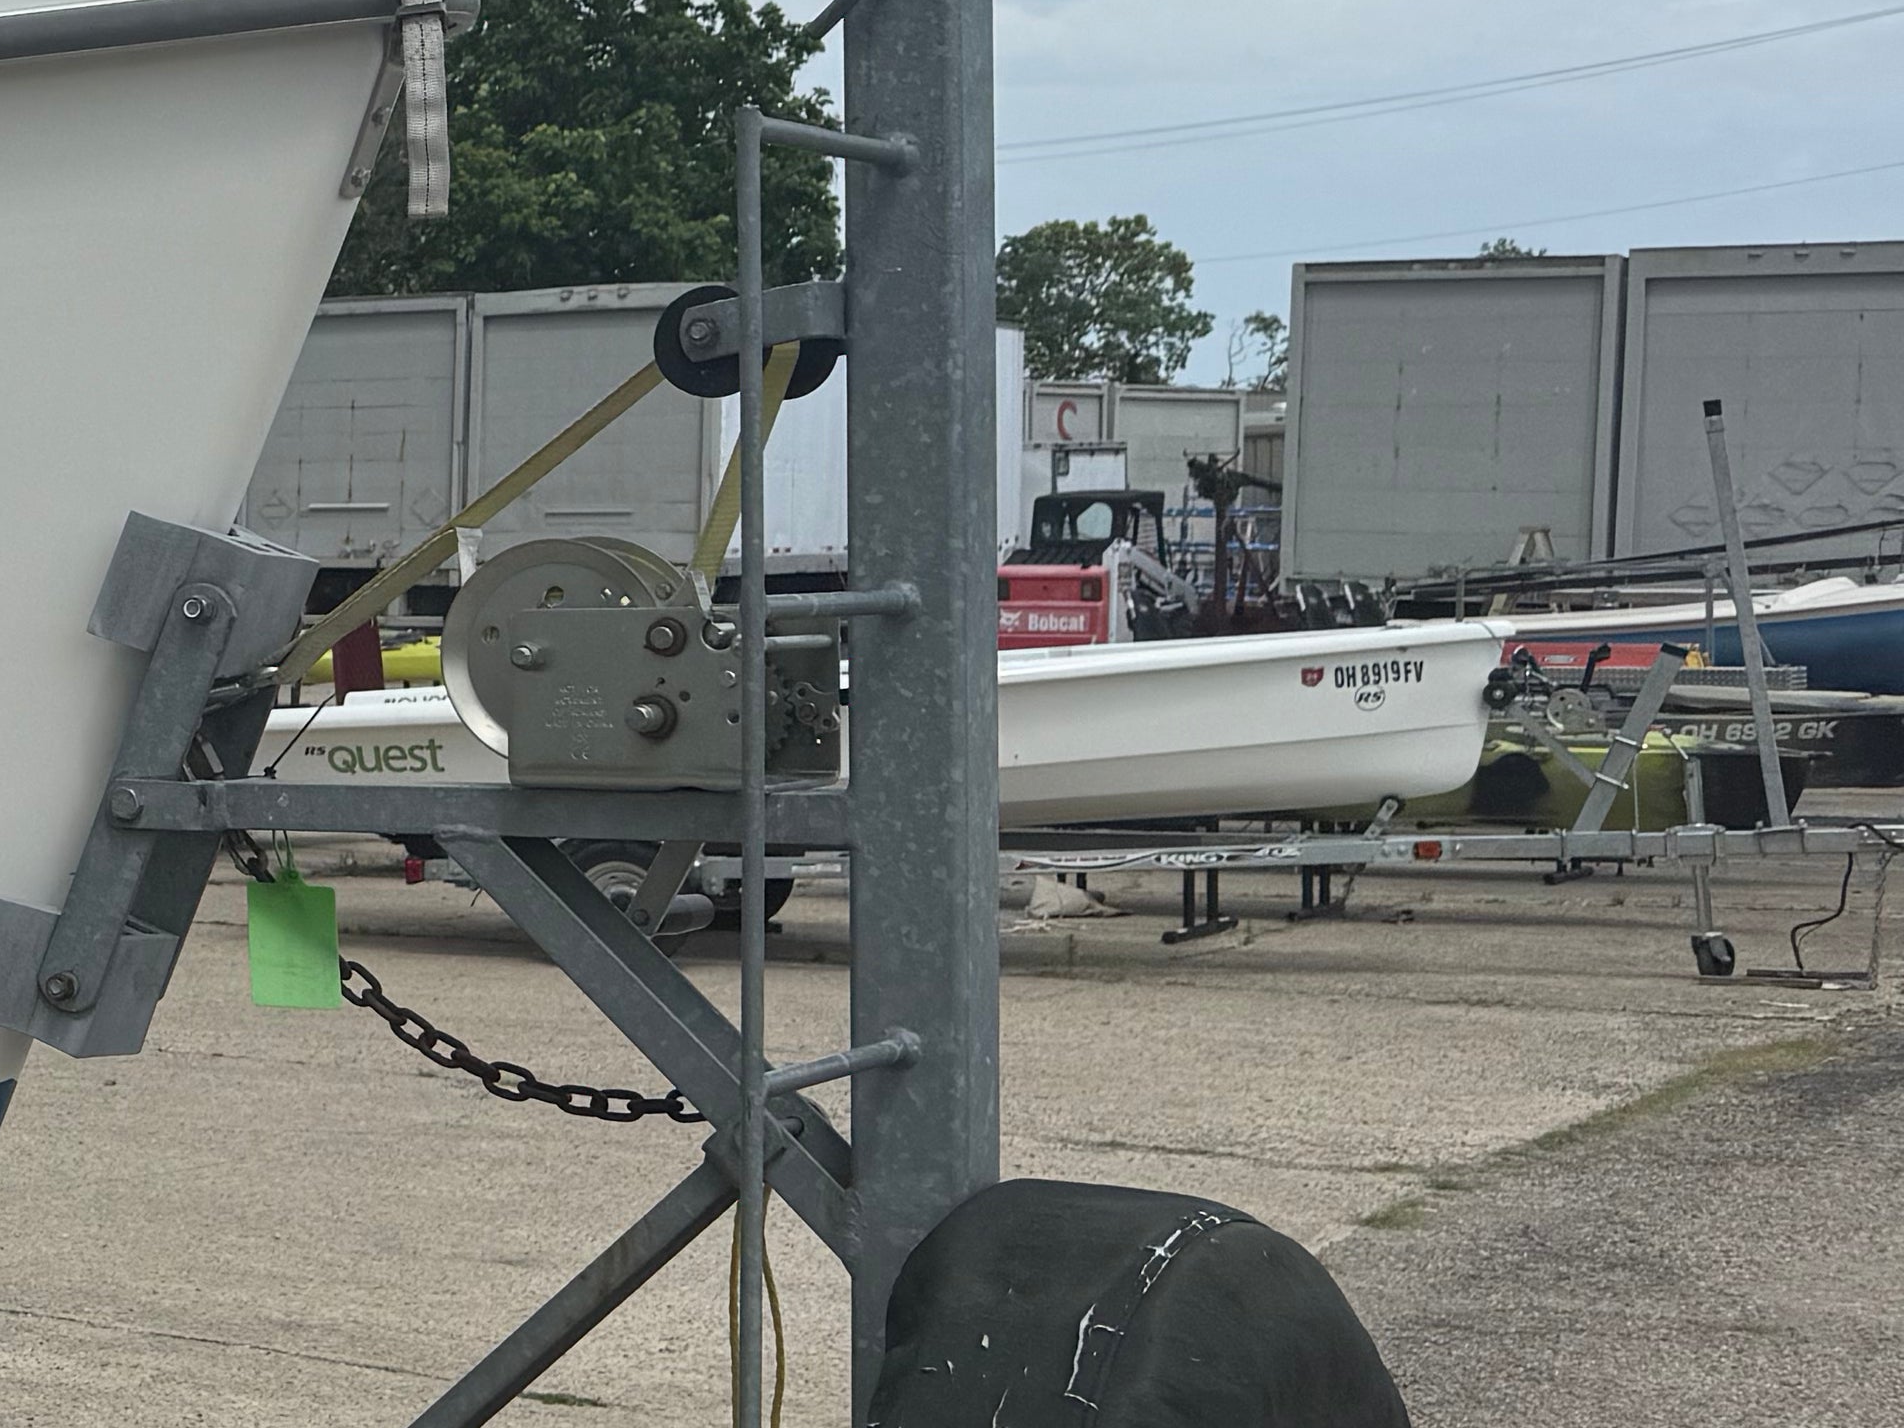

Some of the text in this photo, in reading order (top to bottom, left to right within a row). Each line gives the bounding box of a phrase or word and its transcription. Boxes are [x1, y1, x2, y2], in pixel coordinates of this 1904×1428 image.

[1028, 613, 1085, 632] Bobcat
[1334, 666, 1357, 688] OH
[1798, 721, 1838, 740] GK
[327, 738, 446, 775] Quest
